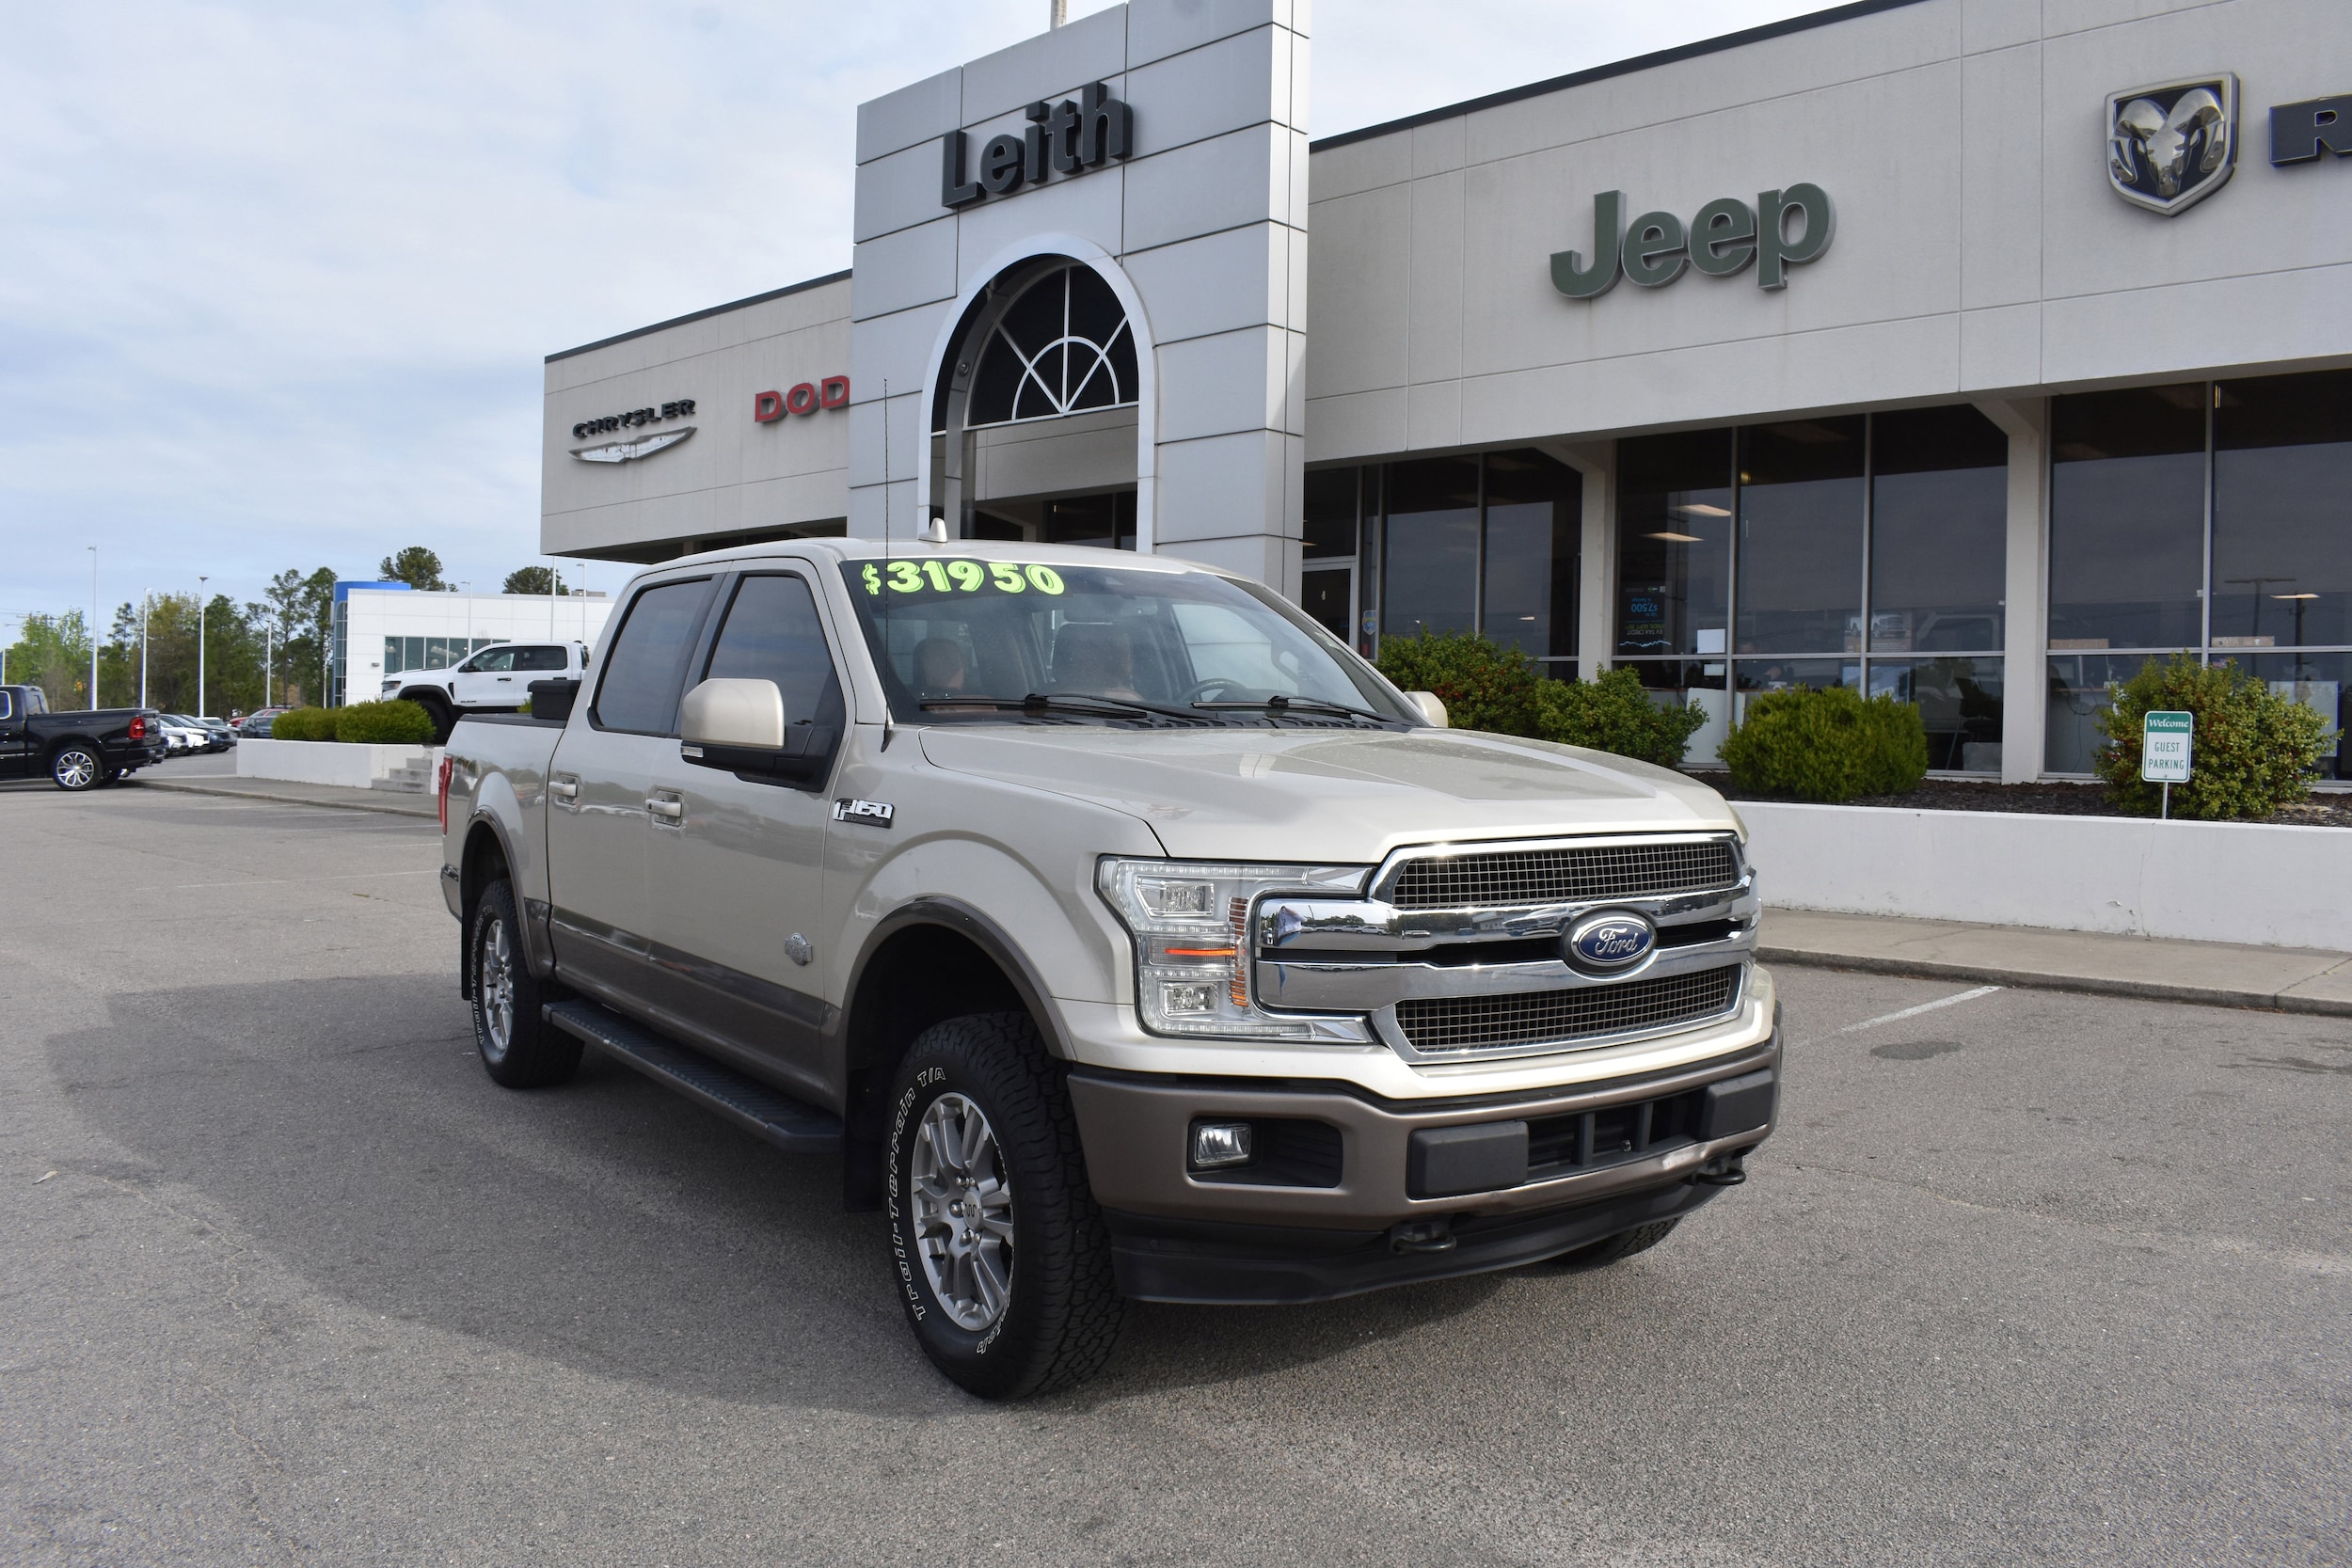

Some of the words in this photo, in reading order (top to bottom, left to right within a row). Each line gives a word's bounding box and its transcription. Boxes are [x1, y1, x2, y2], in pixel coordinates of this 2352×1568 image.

[942, 81, 1134, 209] Leith
[1549, 182, 1836, 299] Jeep
[572, 399, 696, 438] CHRYSLER
[862, 561, 1065, 595] $31950
[2149, 719, 2189, 728] Welcome
[2154, 742, 2180, 752] GUEST
[2148, 759, 2185, 769] PARKING
[1595, 927, 1638, 956] Ford
